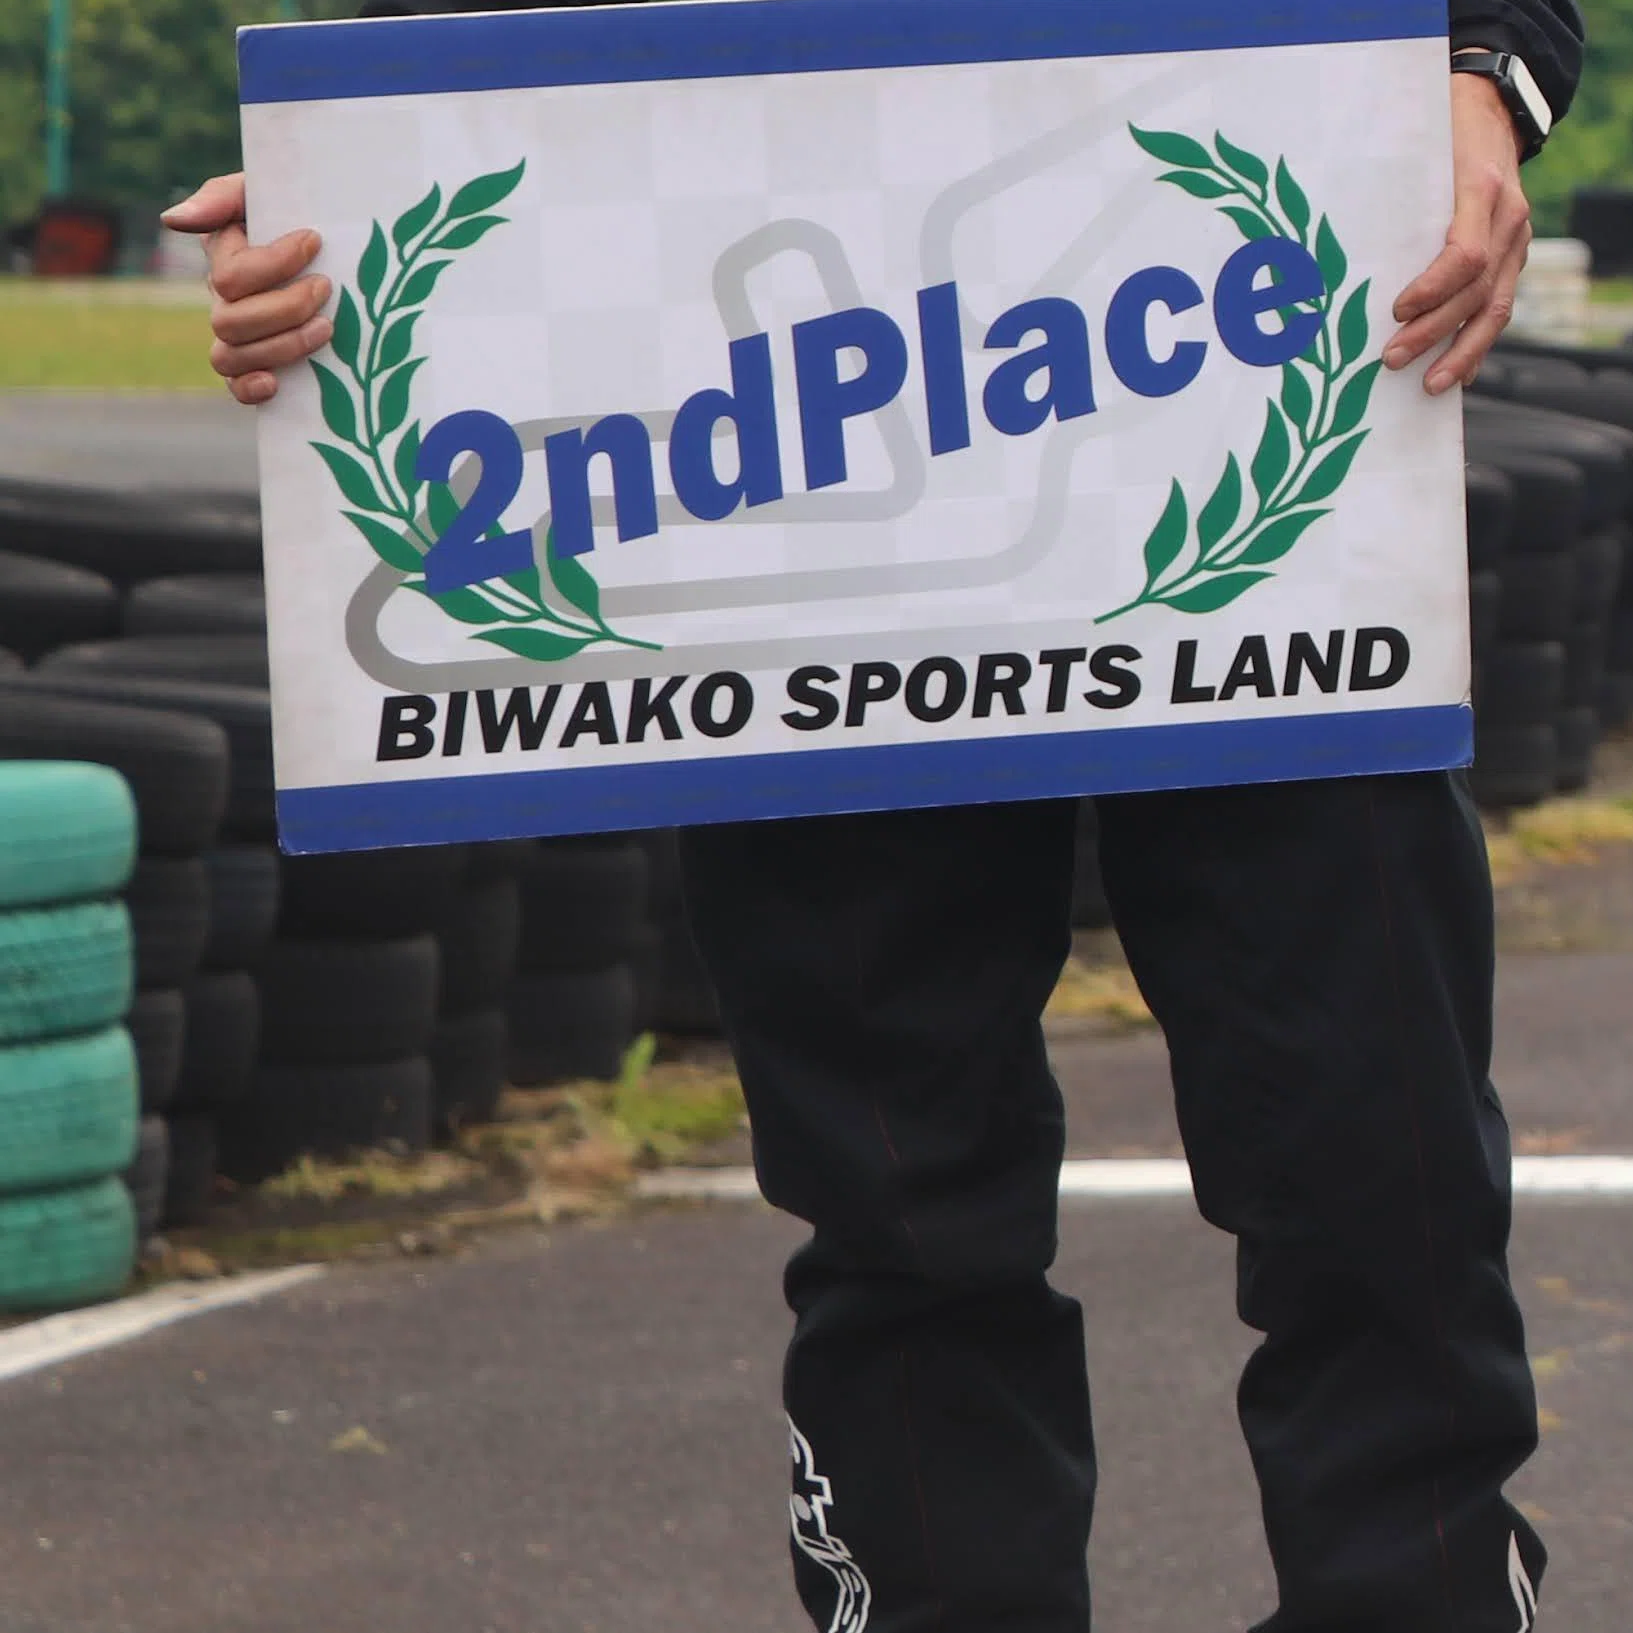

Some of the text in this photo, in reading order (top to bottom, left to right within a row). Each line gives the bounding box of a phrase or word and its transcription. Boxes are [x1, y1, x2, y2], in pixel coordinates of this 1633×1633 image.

[375, 626, 1412, 764] BIWAKO SPORTS LAND
